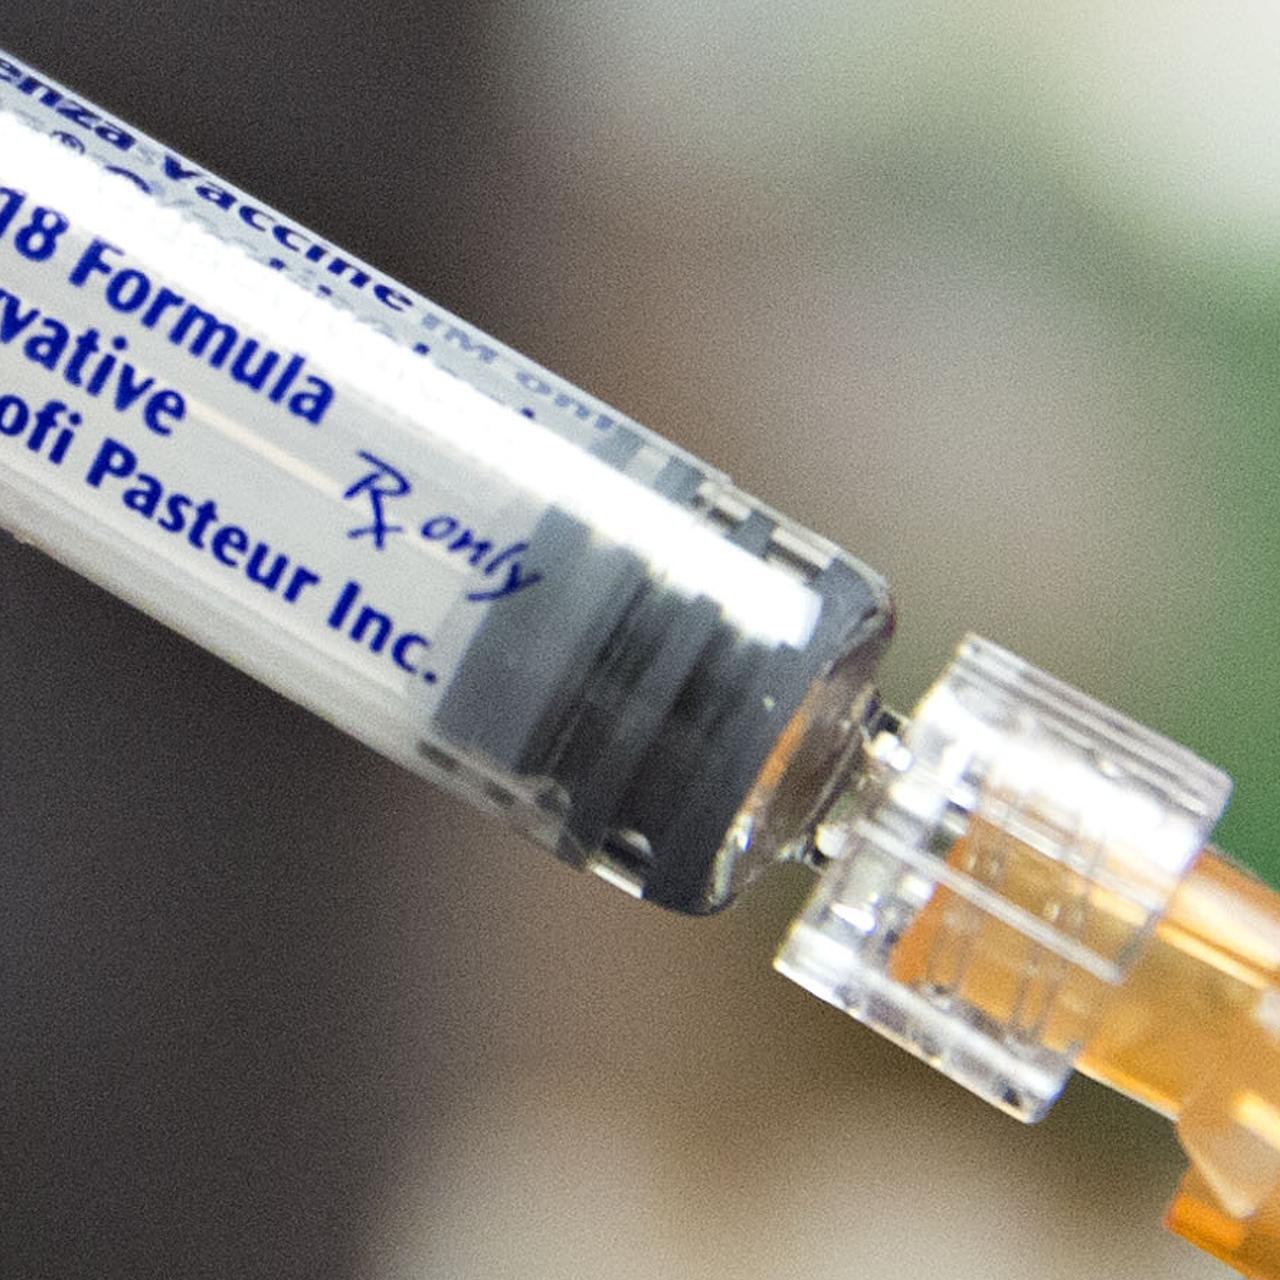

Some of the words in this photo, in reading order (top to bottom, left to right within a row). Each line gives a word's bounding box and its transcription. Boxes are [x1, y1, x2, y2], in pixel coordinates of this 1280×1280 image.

[163, 154, 414, 312] Vaccine
[67, 236, 335, 426] Formula
[84, 436, 320, 604] Pasteur
[326, 580, 438, 685] Inc.
[418, 514, 543, 603] only
